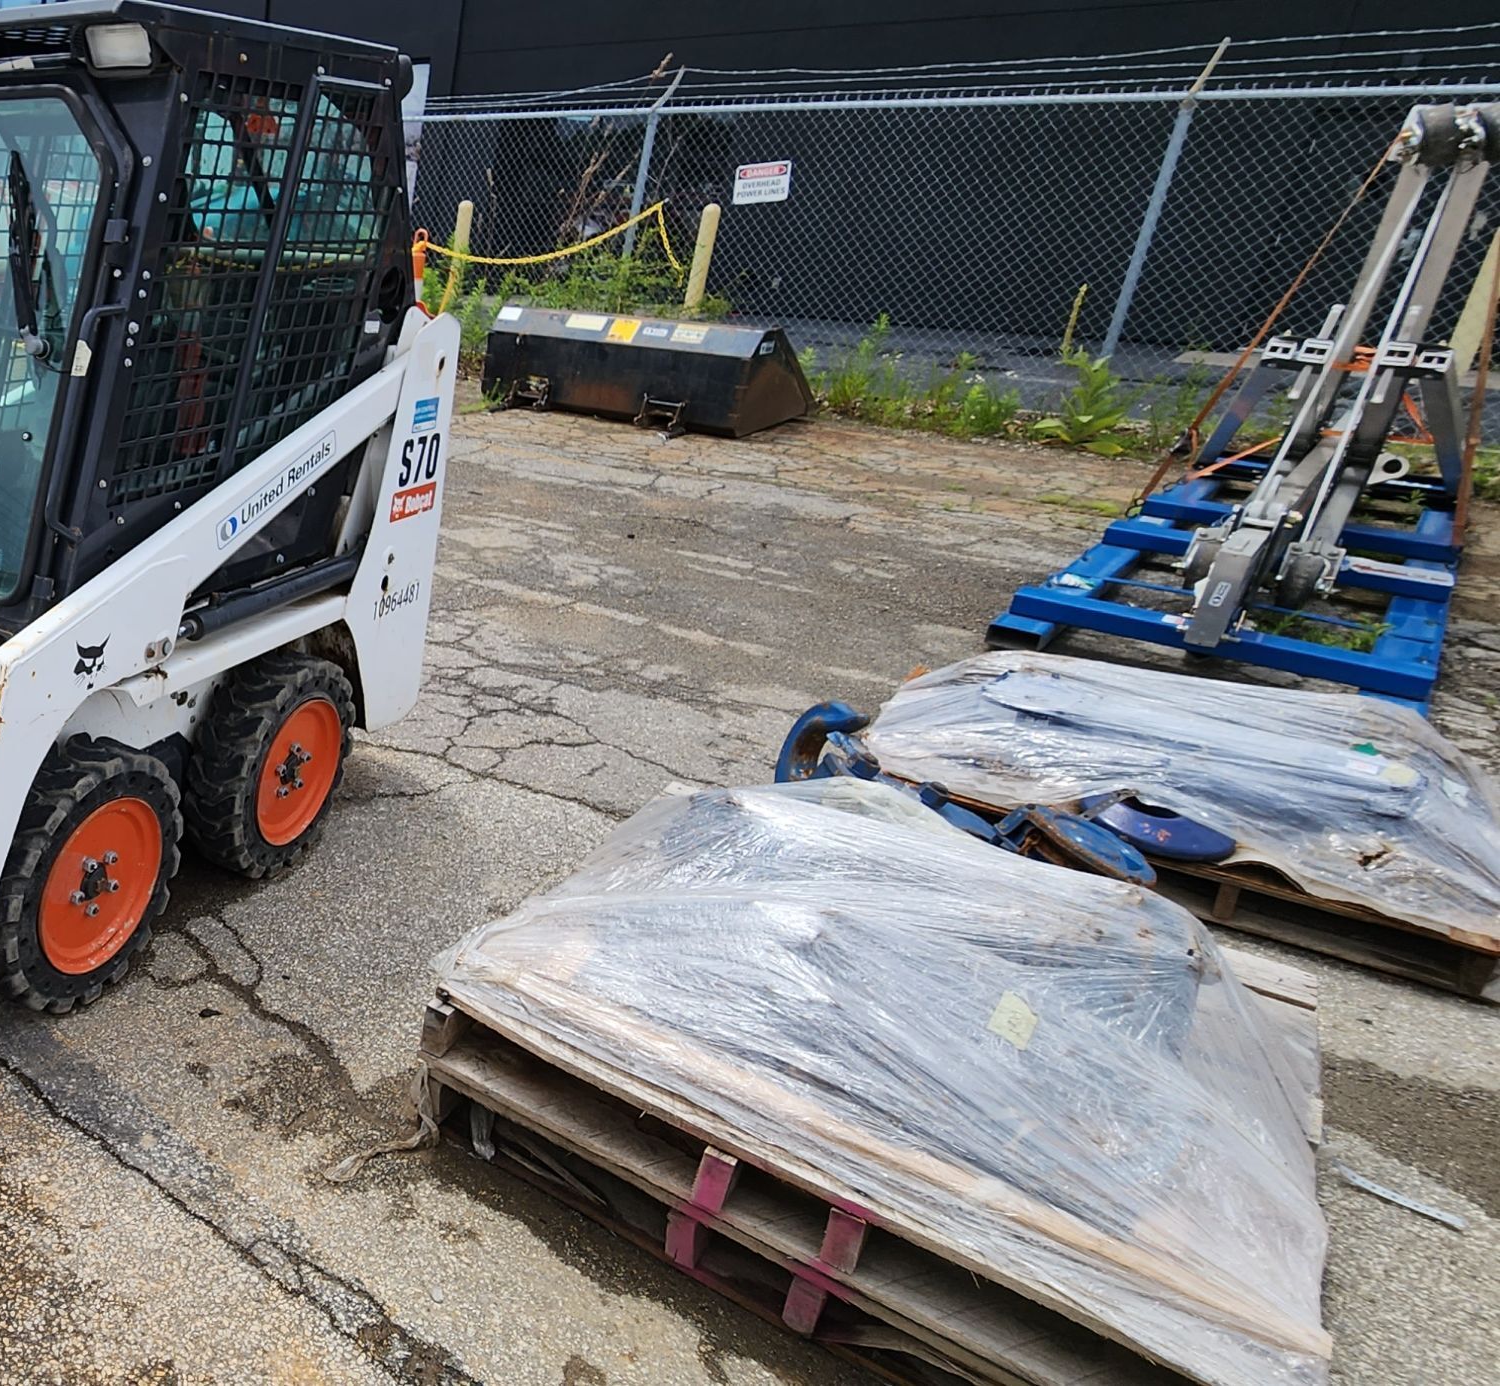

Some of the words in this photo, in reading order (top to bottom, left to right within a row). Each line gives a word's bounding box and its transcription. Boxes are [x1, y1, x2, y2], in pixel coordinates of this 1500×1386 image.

[742, 179, 781, 189] OVERHEAD
[747, 165, 779, 177] DANGER
[736, 190, 763, 198] POWER
[764, 187, 786, 196] LINES
[399, 433, 440, 487] S70
[241, 477, 284, 525] United
[287, 442, 331, 487] Rentals
[404, 489, 433, 515] Bobcat
[373, 581, 420, 621] 10964481
